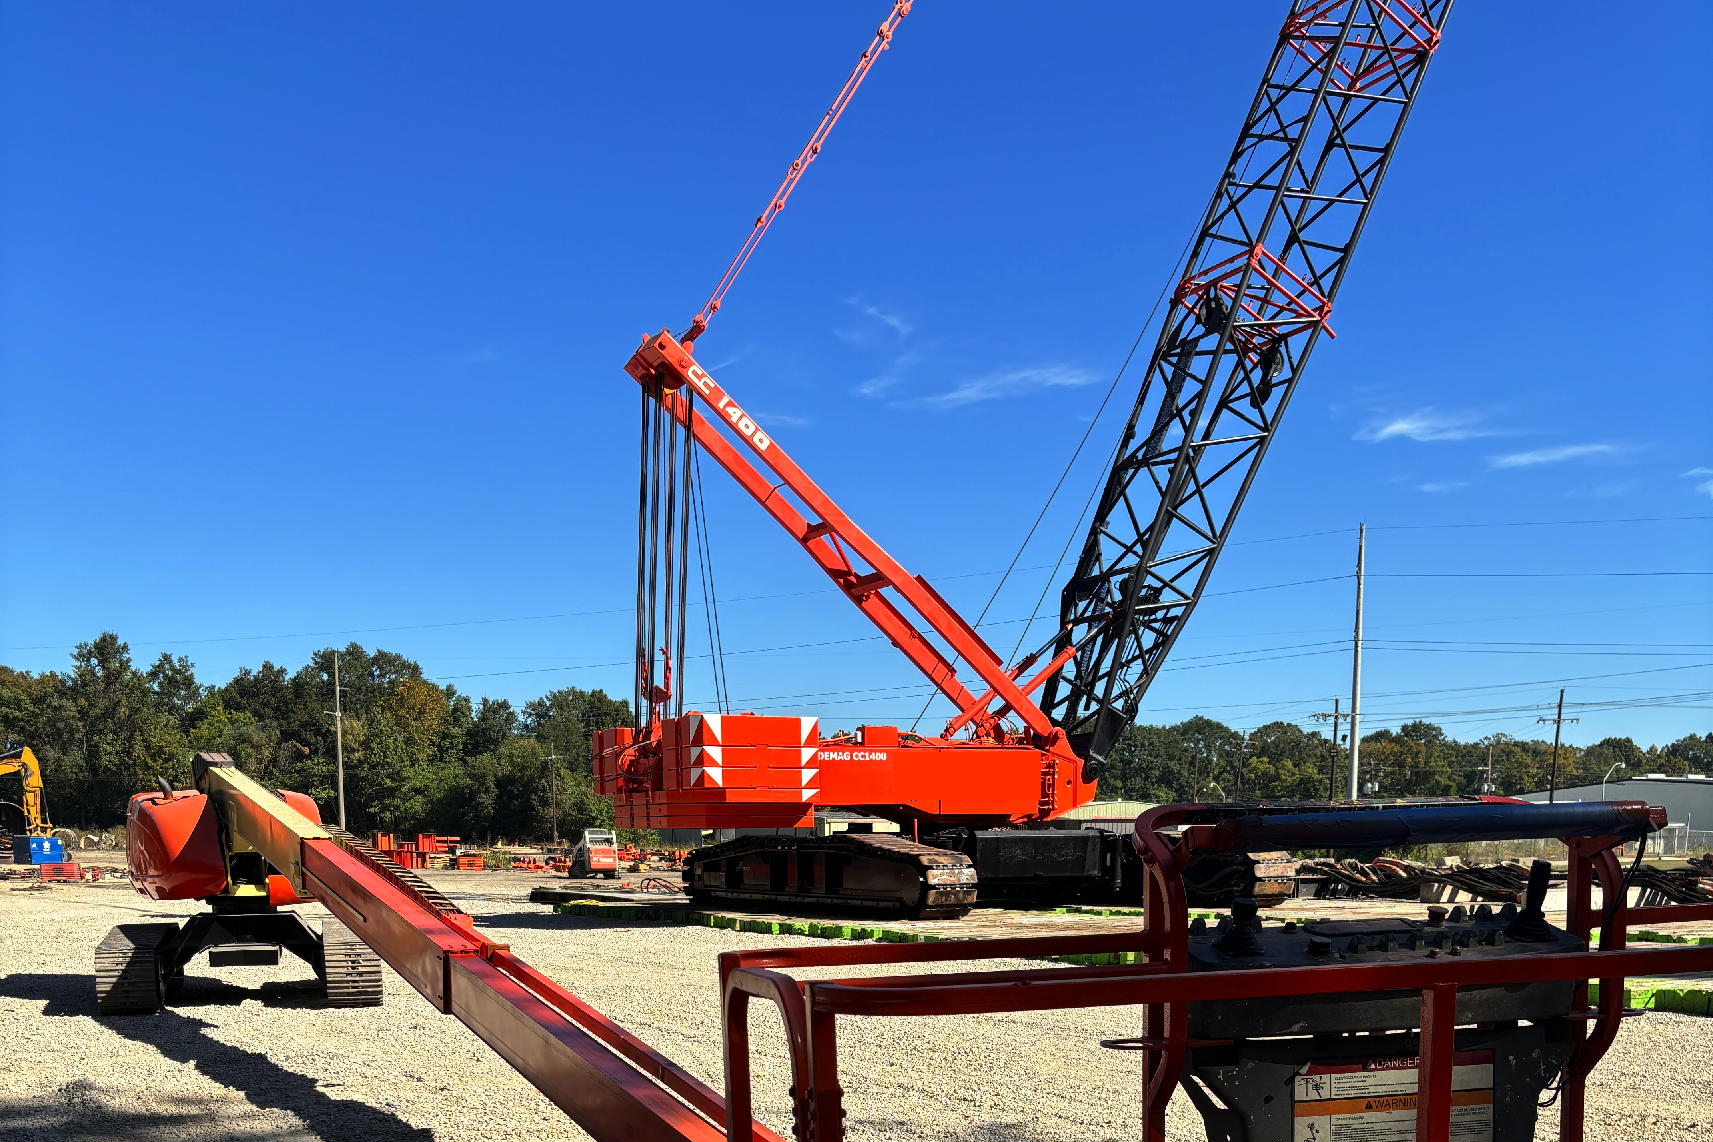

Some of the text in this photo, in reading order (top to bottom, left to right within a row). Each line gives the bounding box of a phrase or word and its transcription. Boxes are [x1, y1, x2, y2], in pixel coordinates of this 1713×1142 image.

[687, 364, 771, 452] CC 1400
[818, 751, 887, 761] DEMAG CC1400
[1373, 1098, 1417, 1110] WARNIN
